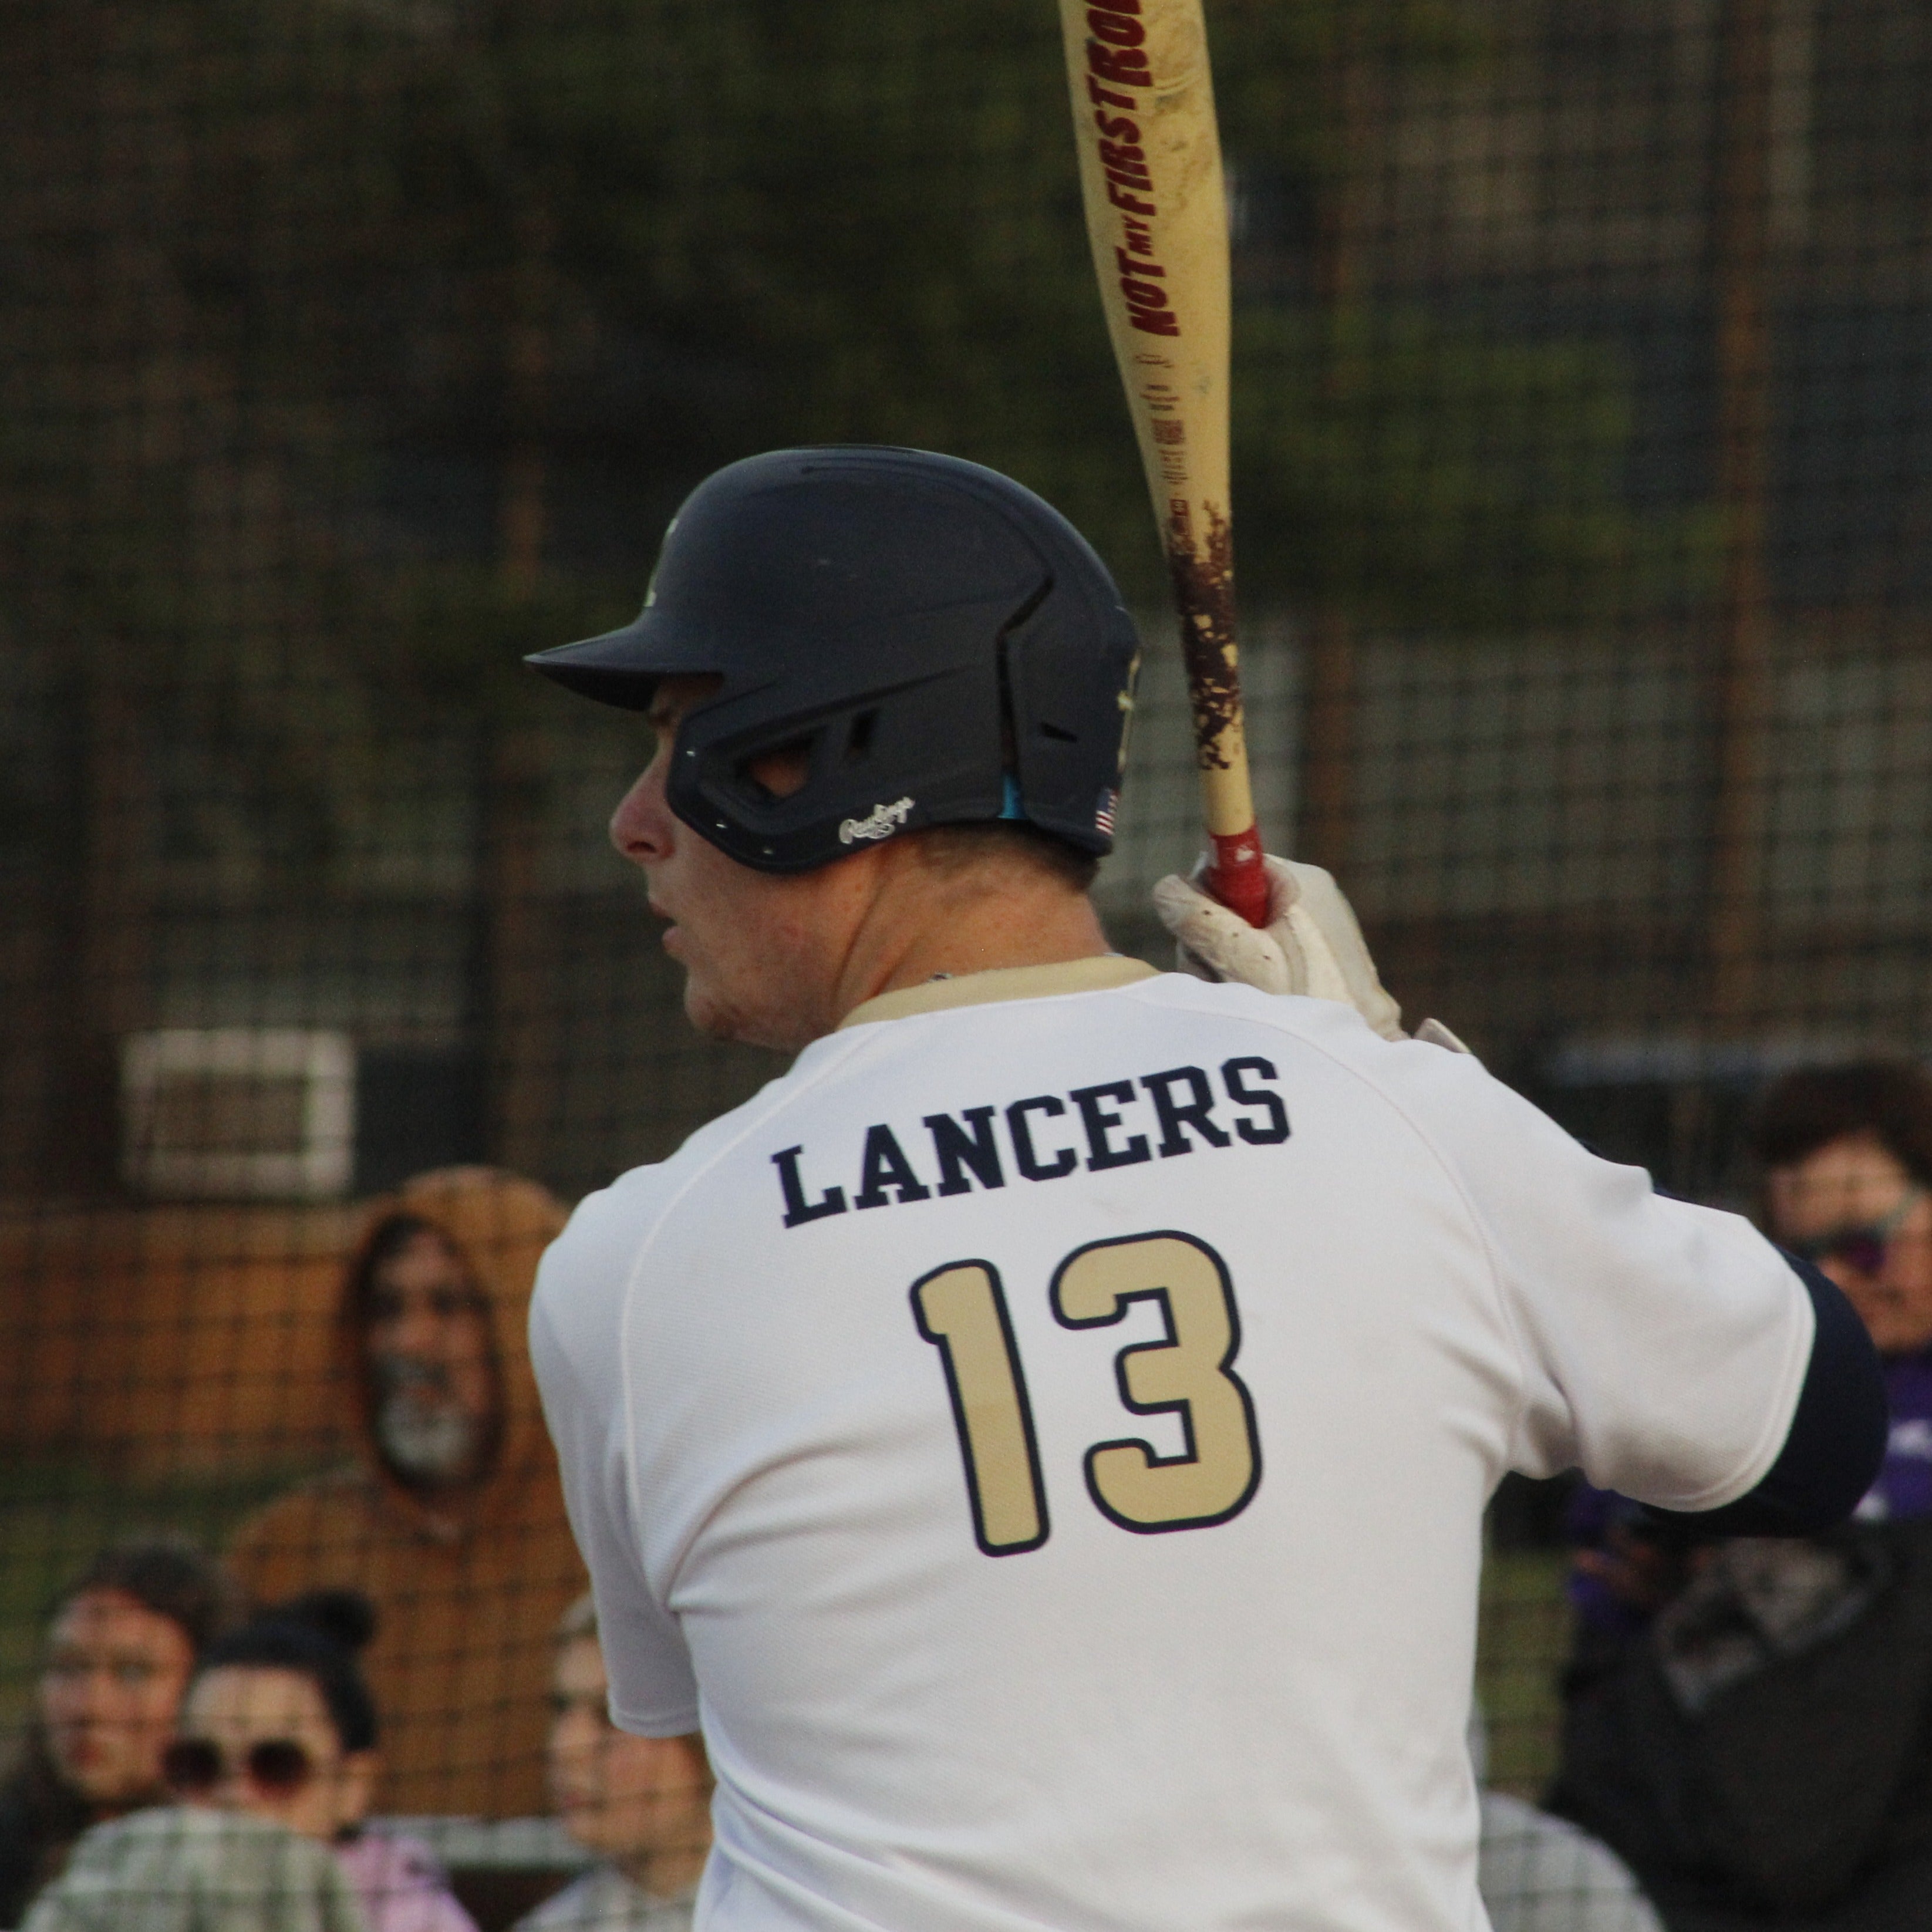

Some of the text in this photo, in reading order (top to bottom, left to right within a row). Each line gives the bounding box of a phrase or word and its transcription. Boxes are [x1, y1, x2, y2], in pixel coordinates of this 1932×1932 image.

[1085, 73, 1156, 216] FIRST
[1115, 245, 1180, 337] NOT
[1122, 213, 1152, 256] MY
[771, 1056, 1291, 1229] LANCERS
[908, 1229, 1263, 1558] 13
